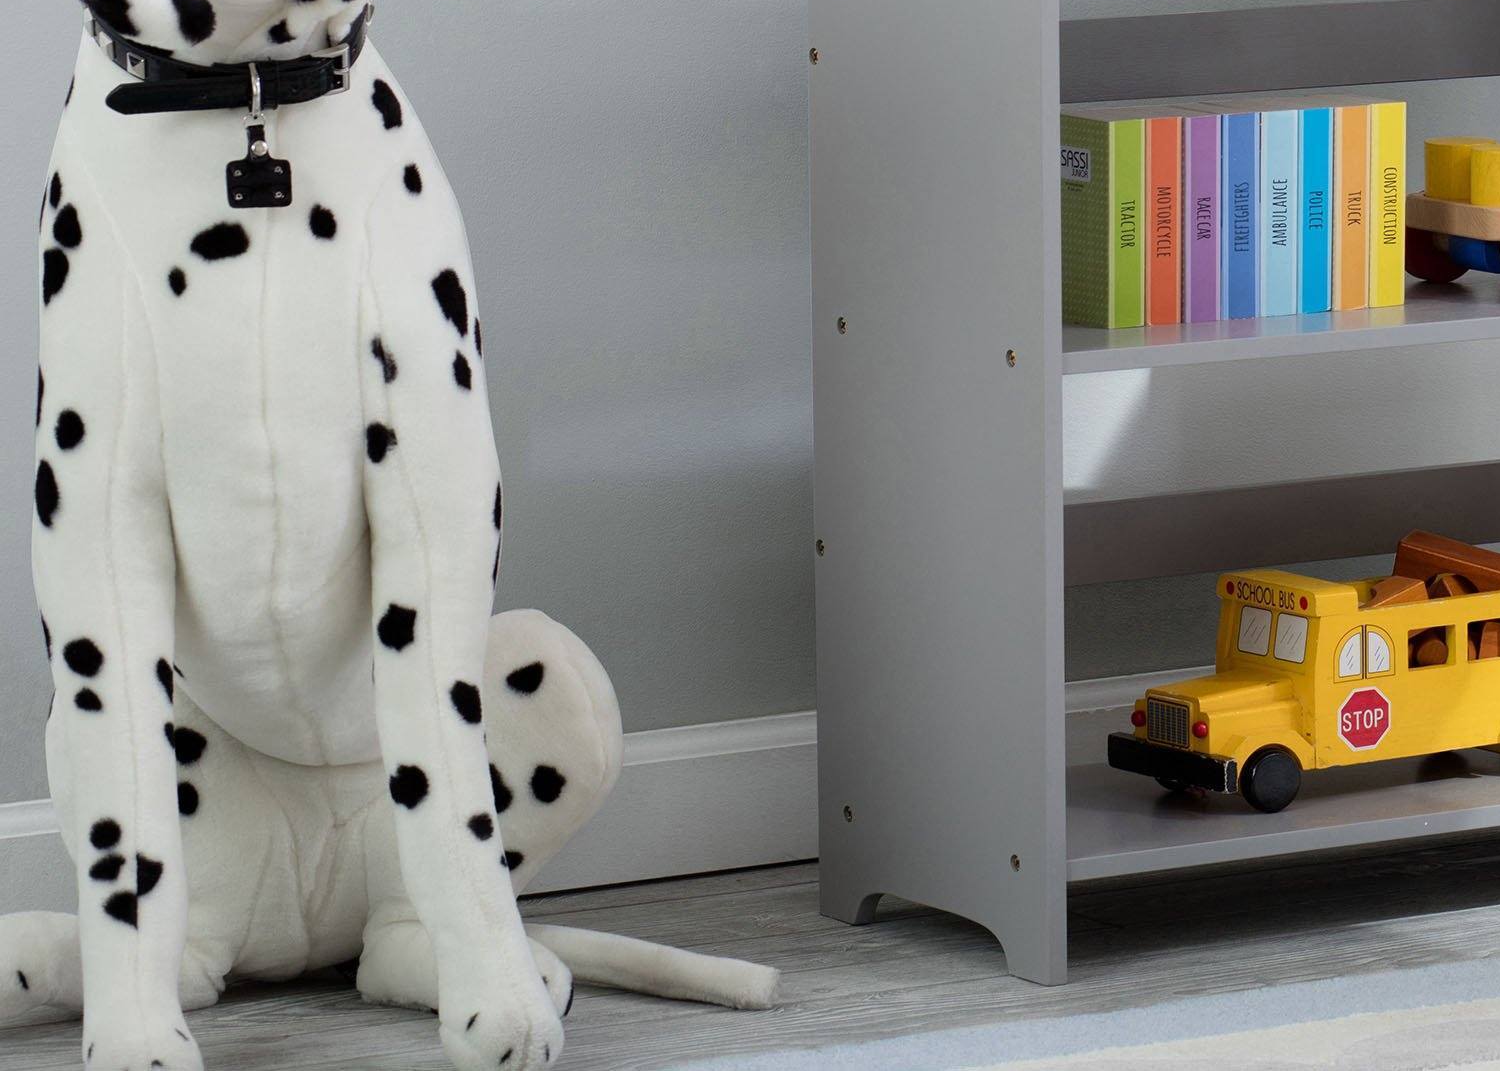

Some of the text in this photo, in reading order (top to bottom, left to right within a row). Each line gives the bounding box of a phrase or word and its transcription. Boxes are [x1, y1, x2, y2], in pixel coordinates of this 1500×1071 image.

[1060, 149, 1089, 170] SASSI
[1120, 199, 1136, 249] TRACTOR
[1156, 186, 1172, 258] MOTORCYCLE
[1196, 196, 1212, 241] RACECAR
[1233, 181, 1250, 253] FIREFIGHTERS
[1271, 178, 1288, 247] AMBULANCE
[1308, 190, 1324, 231] POLICE
[1347, 190, 1362, 227] TRUCK
[1383, 166, 1398, 246] CONSTRUCTION
[1236, 581, 1295, 610] SCHOOL BUS
[1342, 707, 1384, 732] STOP
